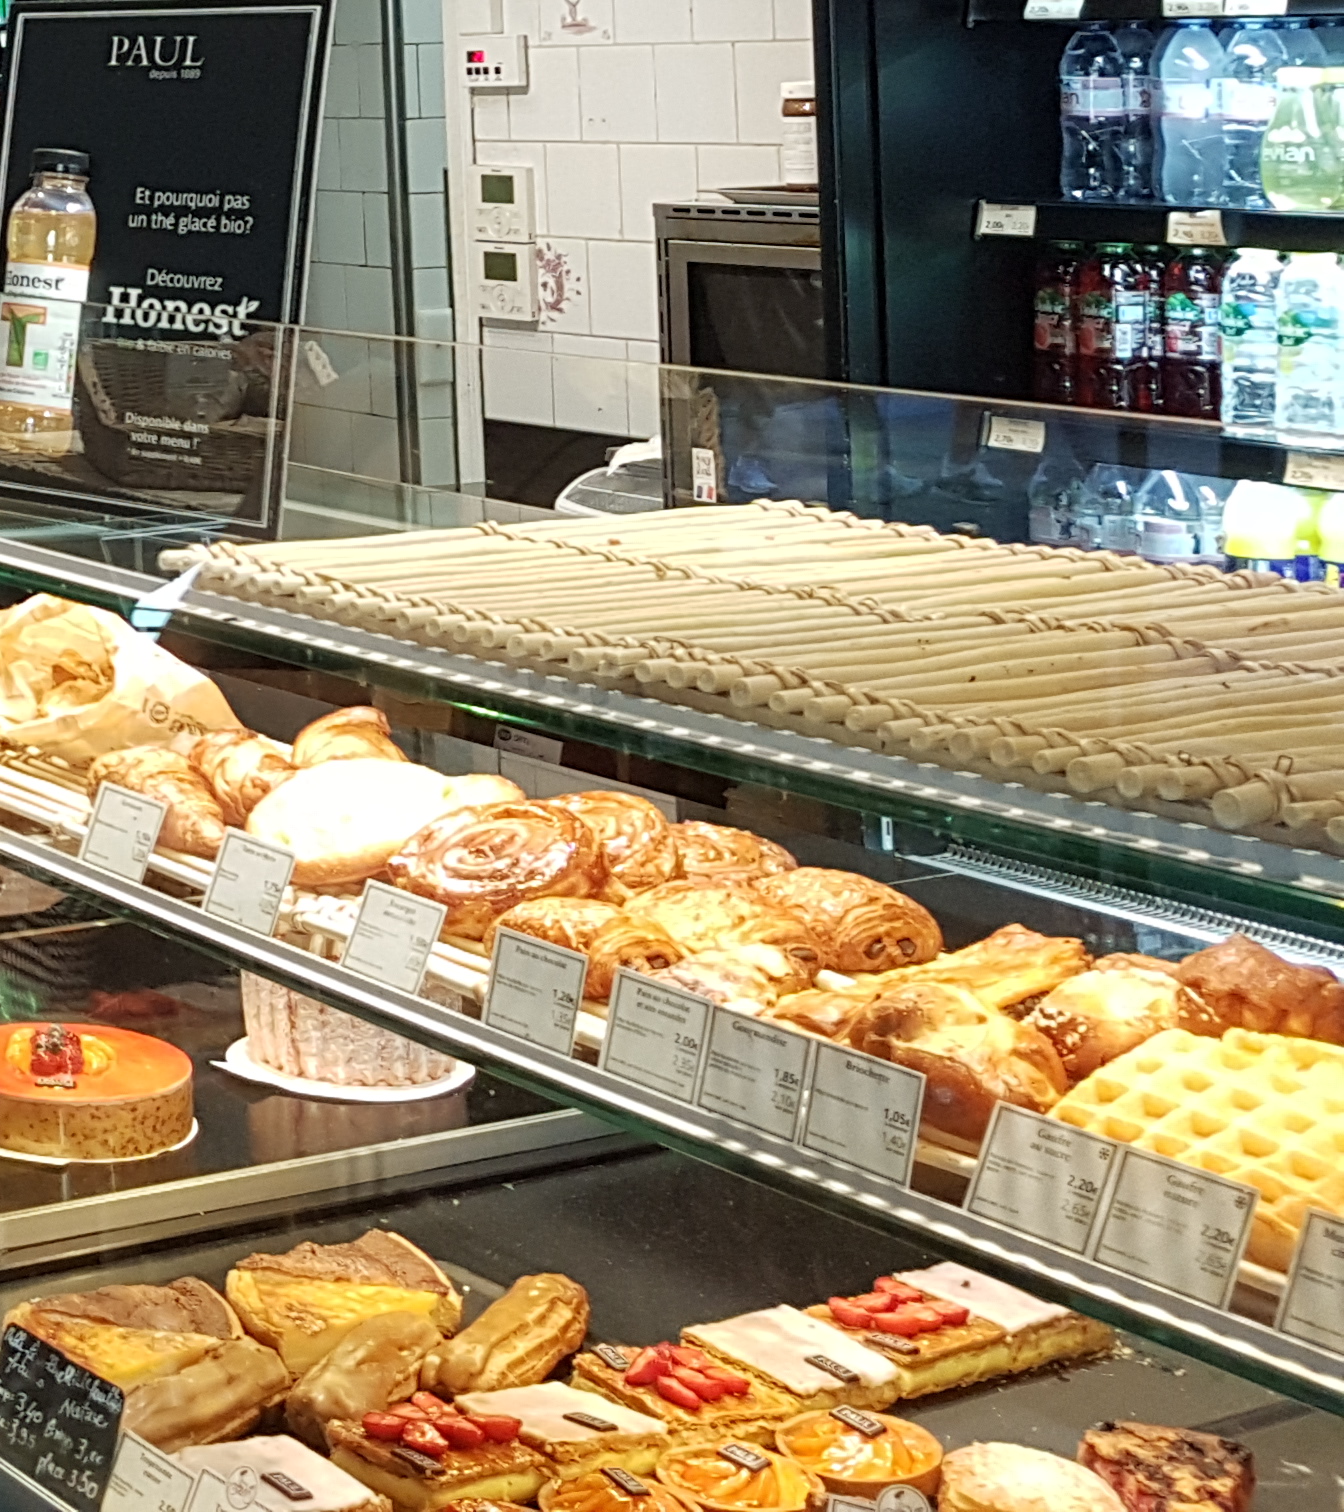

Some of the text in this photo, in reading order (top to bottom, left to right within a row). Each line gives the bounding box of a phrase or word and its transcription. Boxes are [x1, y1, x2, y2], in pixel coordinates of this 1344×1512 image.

[108, 36, 205, 67] PAUL
[149, 70, 177, 80] depuis
[136, 187, 251, 211] Et pourquoi pas
[128, 213, 253, 234] un thé glacé bio?
[146, 268, 223, 291] Découvrez
[102, 286, 260, 337] Honest
[177, 344, 192, 354] en
[194, 345, 232, 360] calories
[126, 412, 210, 434] Disponible dans
[131, 432, 191, 449] votre menu
[774, 1068, 799, 1085] 1,85€
[884, 1108, 911, 1127] 1,05€
[1038, 1129, 1073, 1148] Gaufre
[1044, 1147, 1072, 1162] sucre
[1067, 1175, 1098, 1194] 2,20€
[1167, 1175, 1206, 1195] Gaufre
[1201, 1224, 1235, 1247] 2,20€
[15, 1392, 44, 1424] 3,40
[841, 1409, 875, 1429] PAUL
